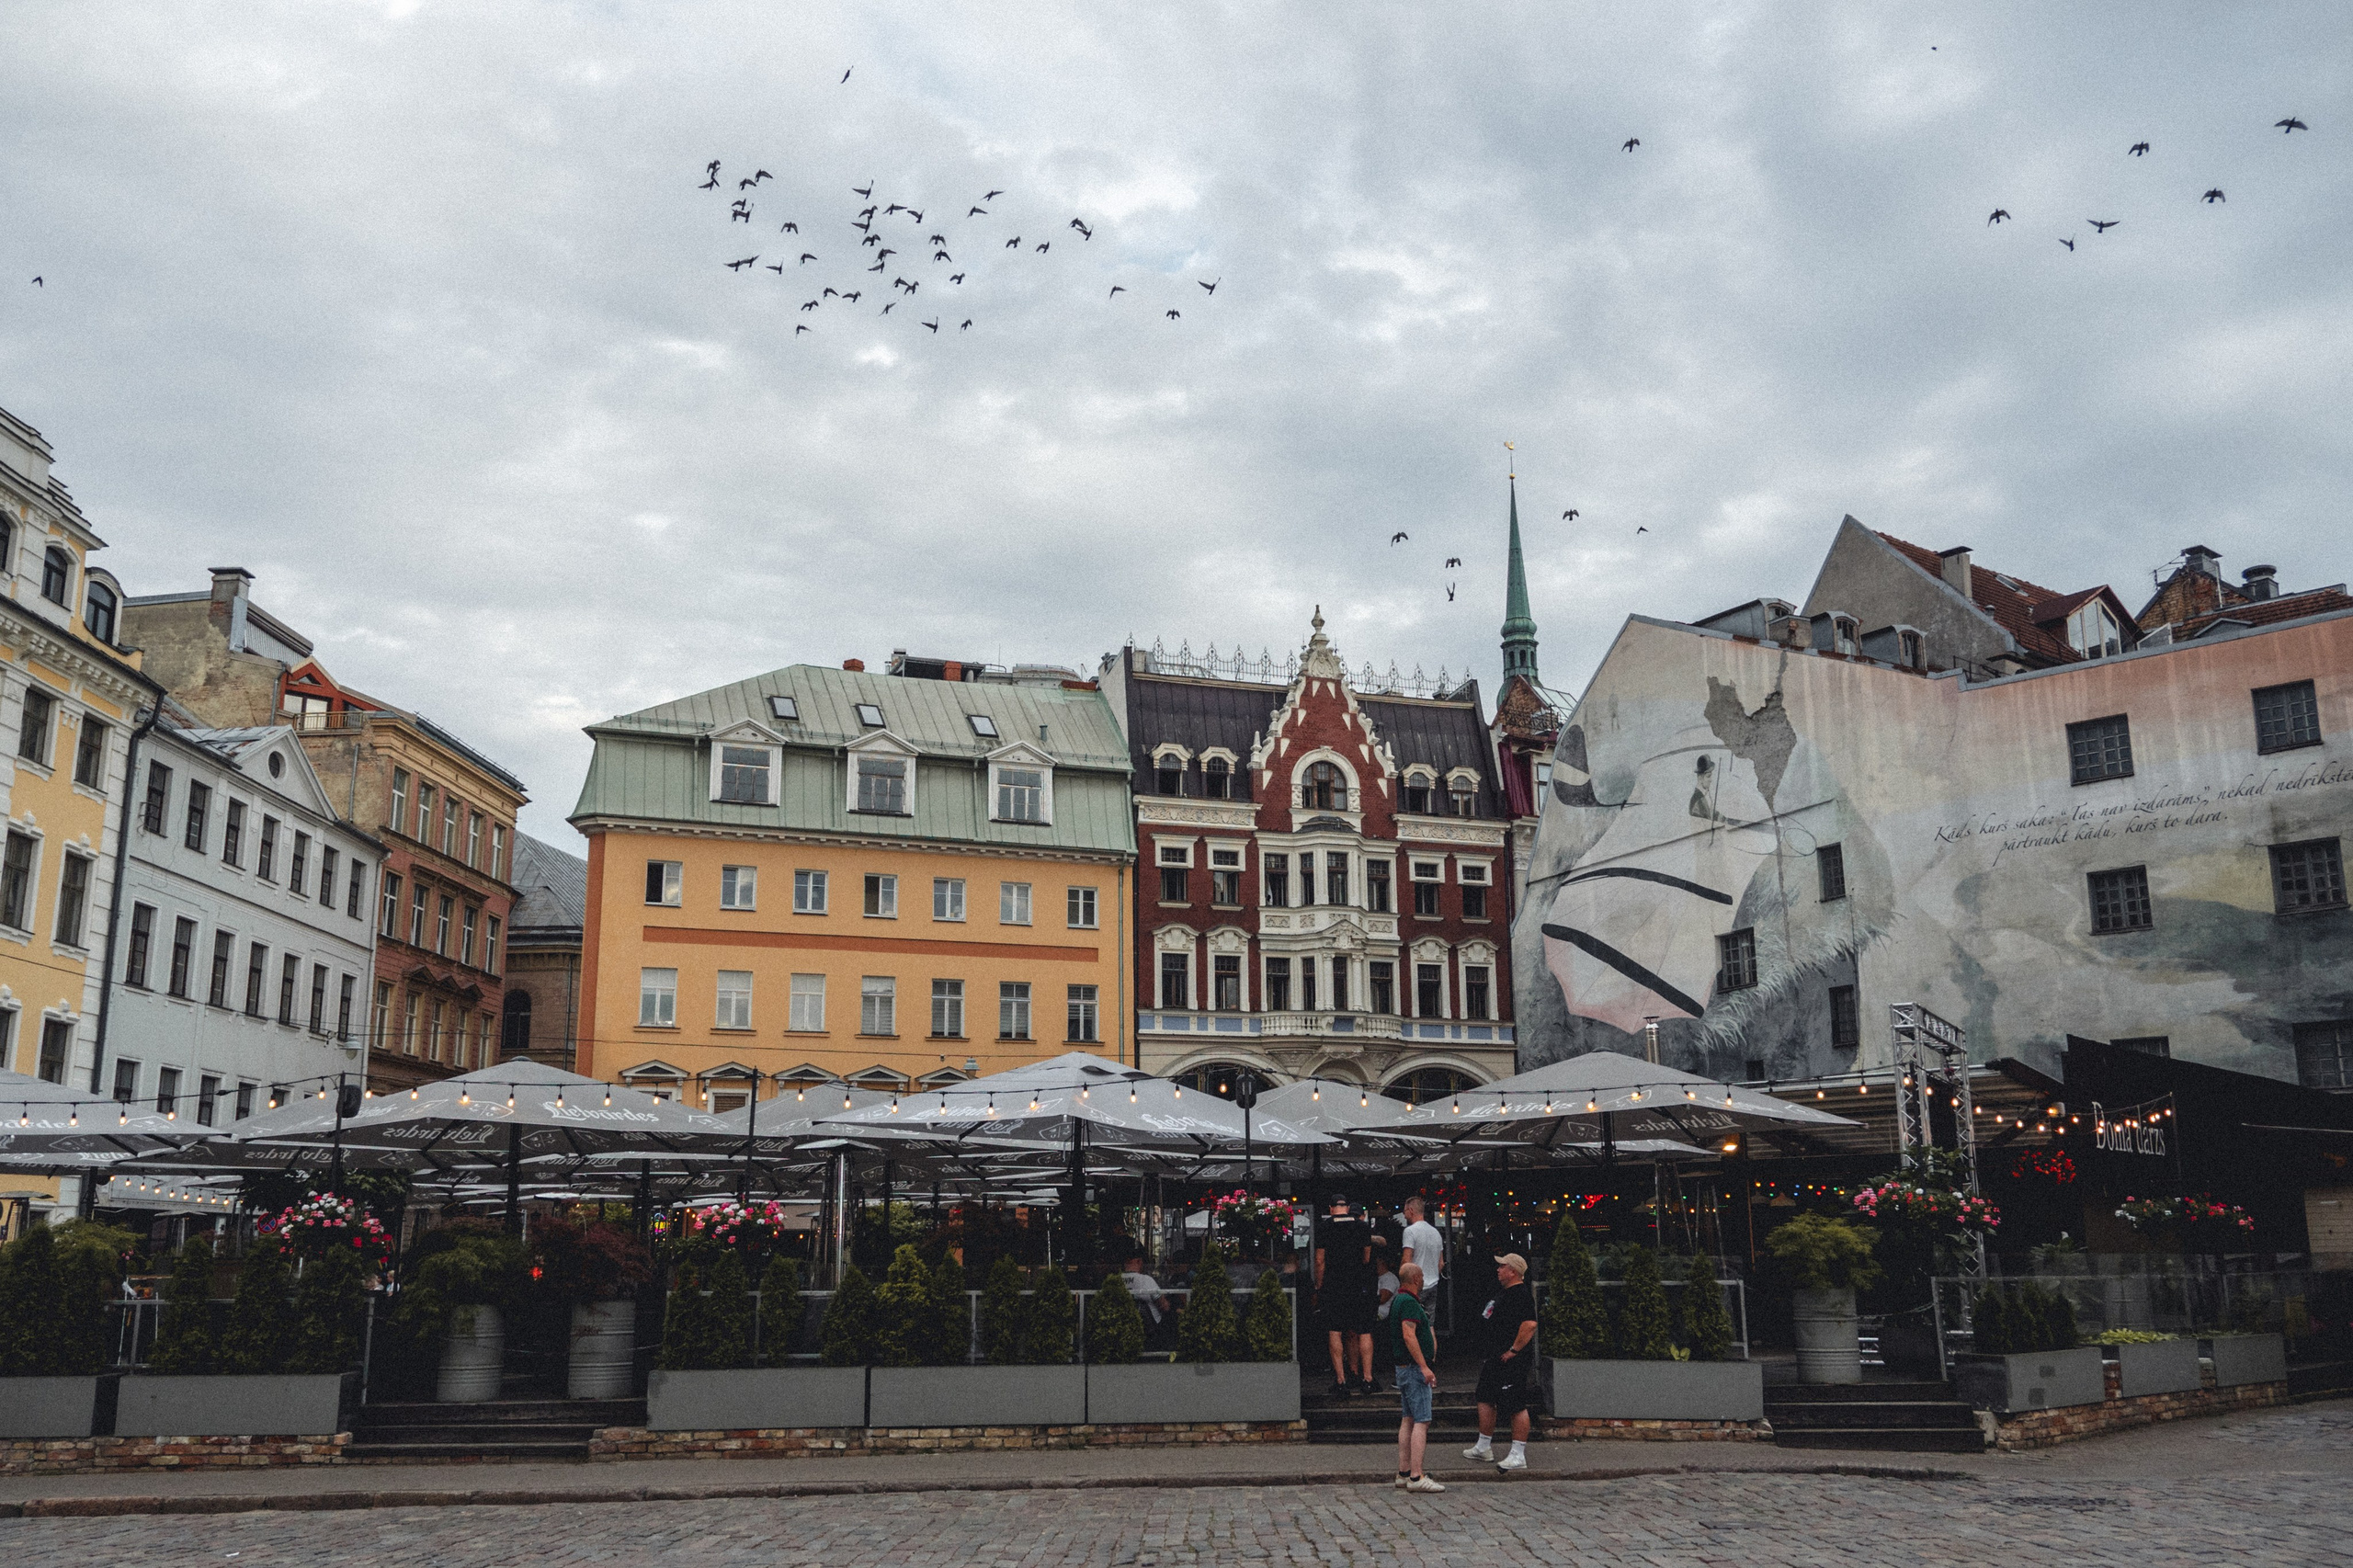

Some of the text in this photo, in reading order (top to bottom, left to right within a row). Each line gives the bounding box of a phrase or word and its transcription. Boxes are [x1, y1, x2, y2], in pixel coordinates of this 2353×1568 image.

[1934, 814, 1976, 844] Kāds
[1979, 812, 2009, 835] kurš
[2100, 803, 2127, 816] nav
[2217, 768, 2279, 800] nekad
[2276, 761, 2353, 791] nedrīkstē
[1993, 824, 2068, 867] pārtraukt
[2125, 815, 2158, 834] kurš
[2164, 814, 2181, 829] to
[2092, 1101, 2133, 1153] Doma
